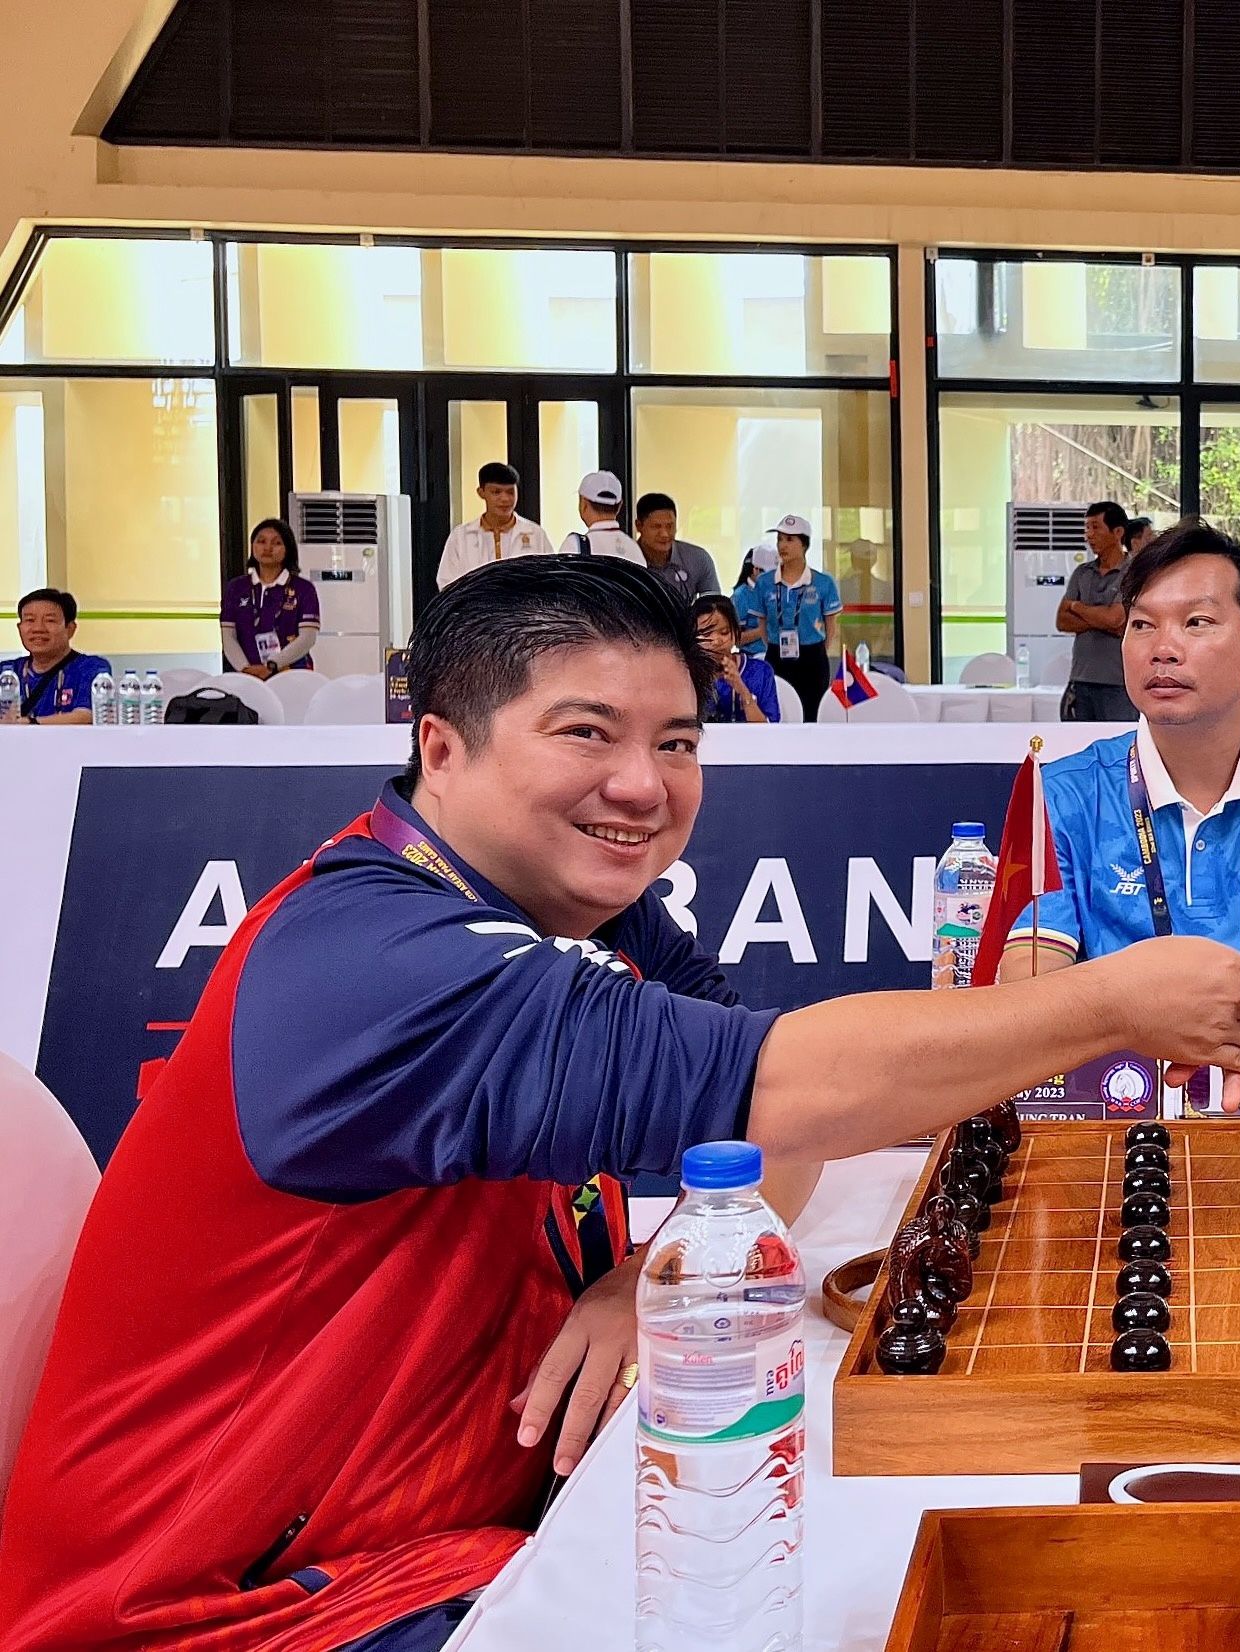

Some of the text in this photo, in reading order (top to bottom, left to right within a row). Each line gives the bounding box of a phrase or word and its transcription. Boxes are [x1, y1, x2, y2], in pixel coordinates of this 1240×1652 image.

[1134, 809, 1152, 865] CAMBODIA 2023
[1035, 1087, 1065, 1098] 2023
